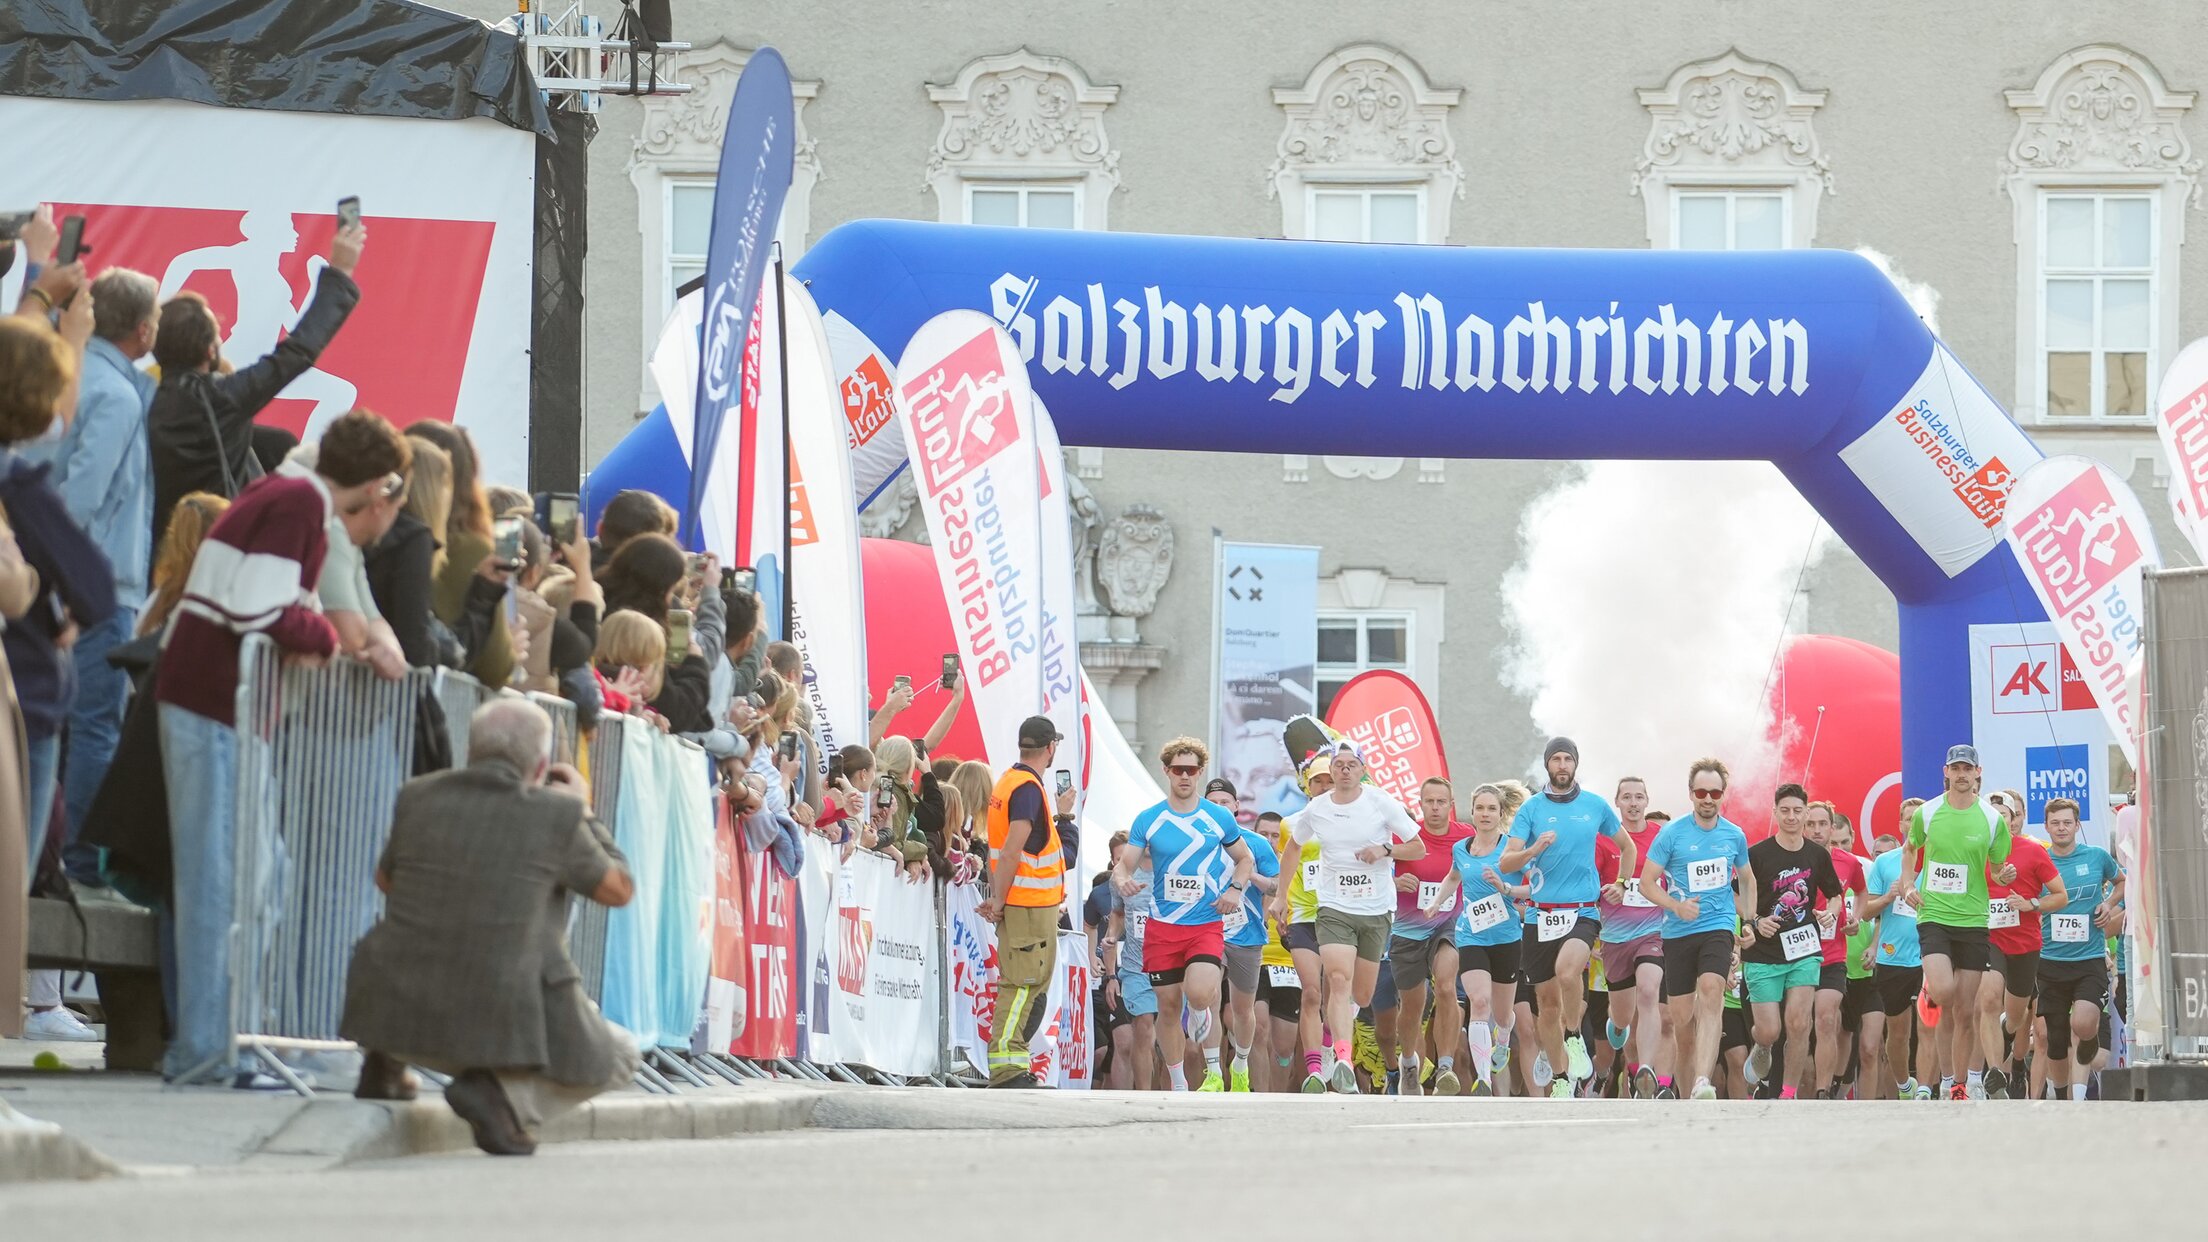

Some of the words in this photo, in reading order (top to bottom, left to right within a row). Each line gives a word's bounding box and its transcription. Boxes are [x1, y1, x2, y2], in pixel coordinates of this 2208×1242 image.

[989, 271, 1388, 405] Salzburger
[1393, 291, 1810, 397] Nachrichten
[1895, 407, 1966, 486] Business
[1914, 399, 1980, 471] Salzburger
[2000, 661, 2051, 697] AK
[2030, 767, 2088, 790] HYPO
[2031, 789, 2088, 801] SALZBURG
